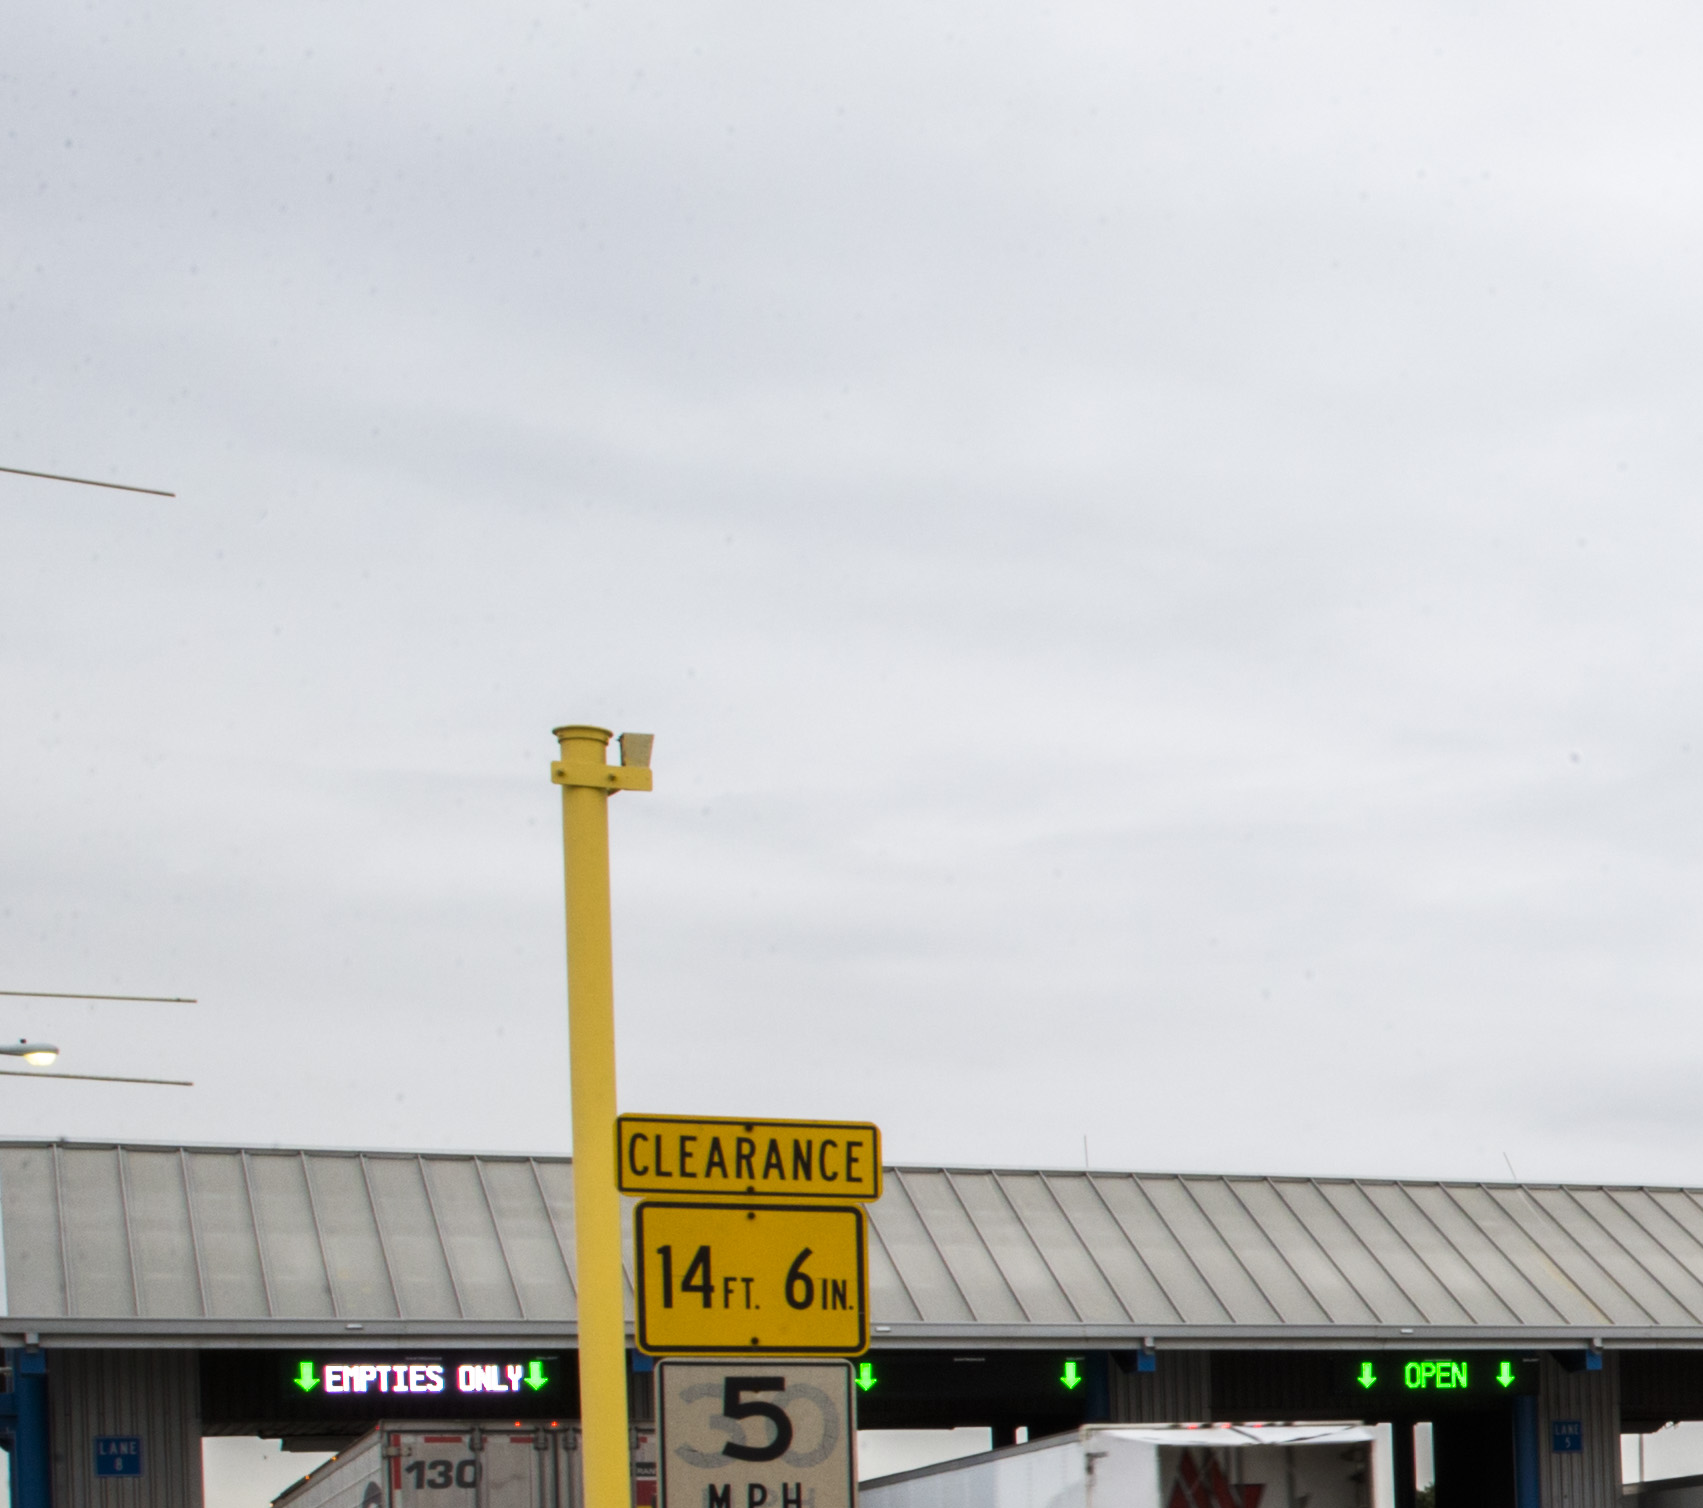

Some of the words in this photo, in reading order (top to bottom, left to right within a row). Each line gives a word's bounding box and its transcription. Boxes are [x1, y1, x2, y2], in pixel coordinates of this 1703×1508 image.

[628, 1132, 864, 1183] CLEARANCE
[656, 1244, 715, 1309] 14
[323, 1363, 445, 1393] EMPTIES
[457, 1363, 525, 1393] ONLY
[1404, 1361, 1468, 1389] OPEN
[721, 1376, 794, 1463] 5
[1554, 1423, 1579, 1436] LANE
[98, 1441, 137, 1455] LANE
[1564, 1437, 1571, 1448] 5
[114, 1457, 123, 1471] 8
[404, 1460, 482, 1490] 130
